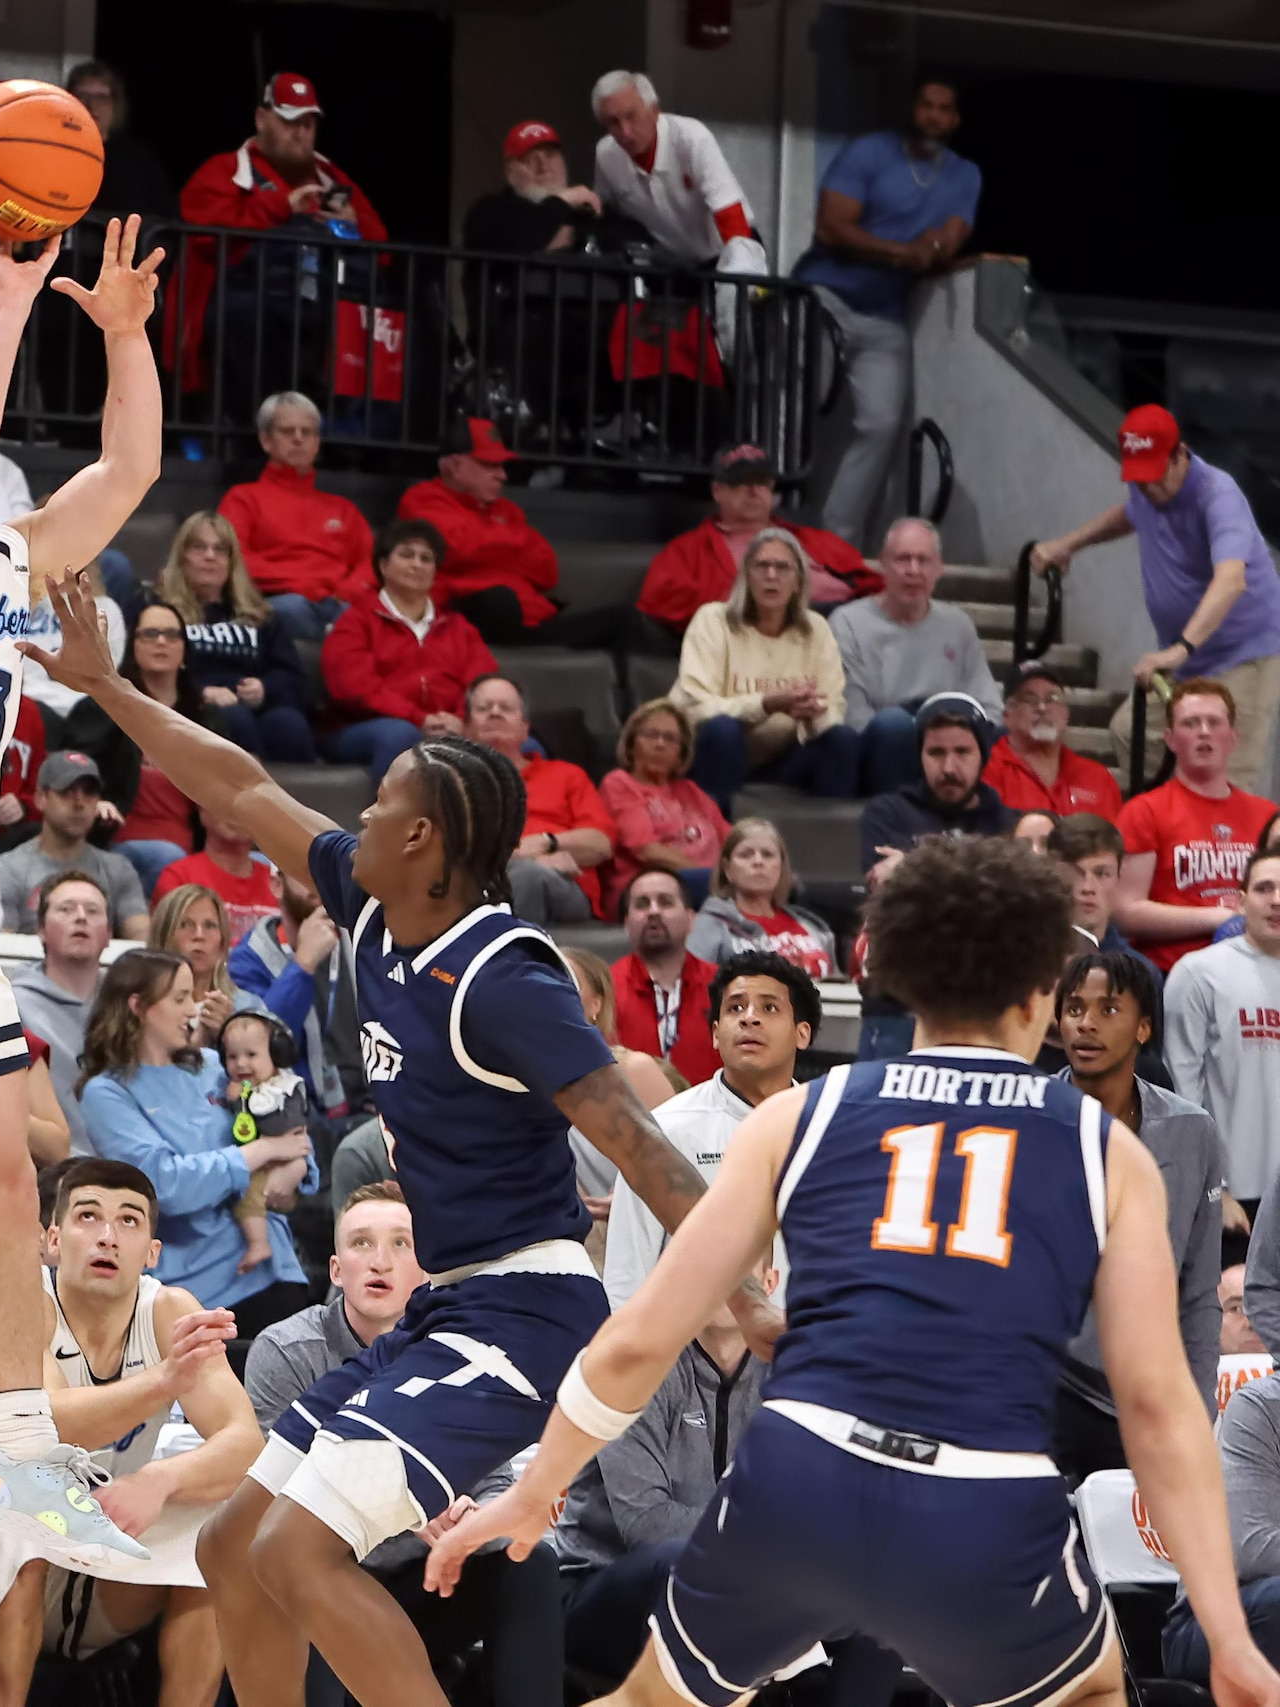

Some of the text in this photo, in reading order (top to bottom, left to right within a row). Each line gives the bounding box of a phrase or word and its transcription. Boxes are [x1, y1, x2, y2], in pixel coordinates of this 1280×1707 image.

[1239, 1007, 1280, 1028] LIB
[878, 1062, 1050, 1109] HORTON
[870, 1120, 1019, 1269] 11
